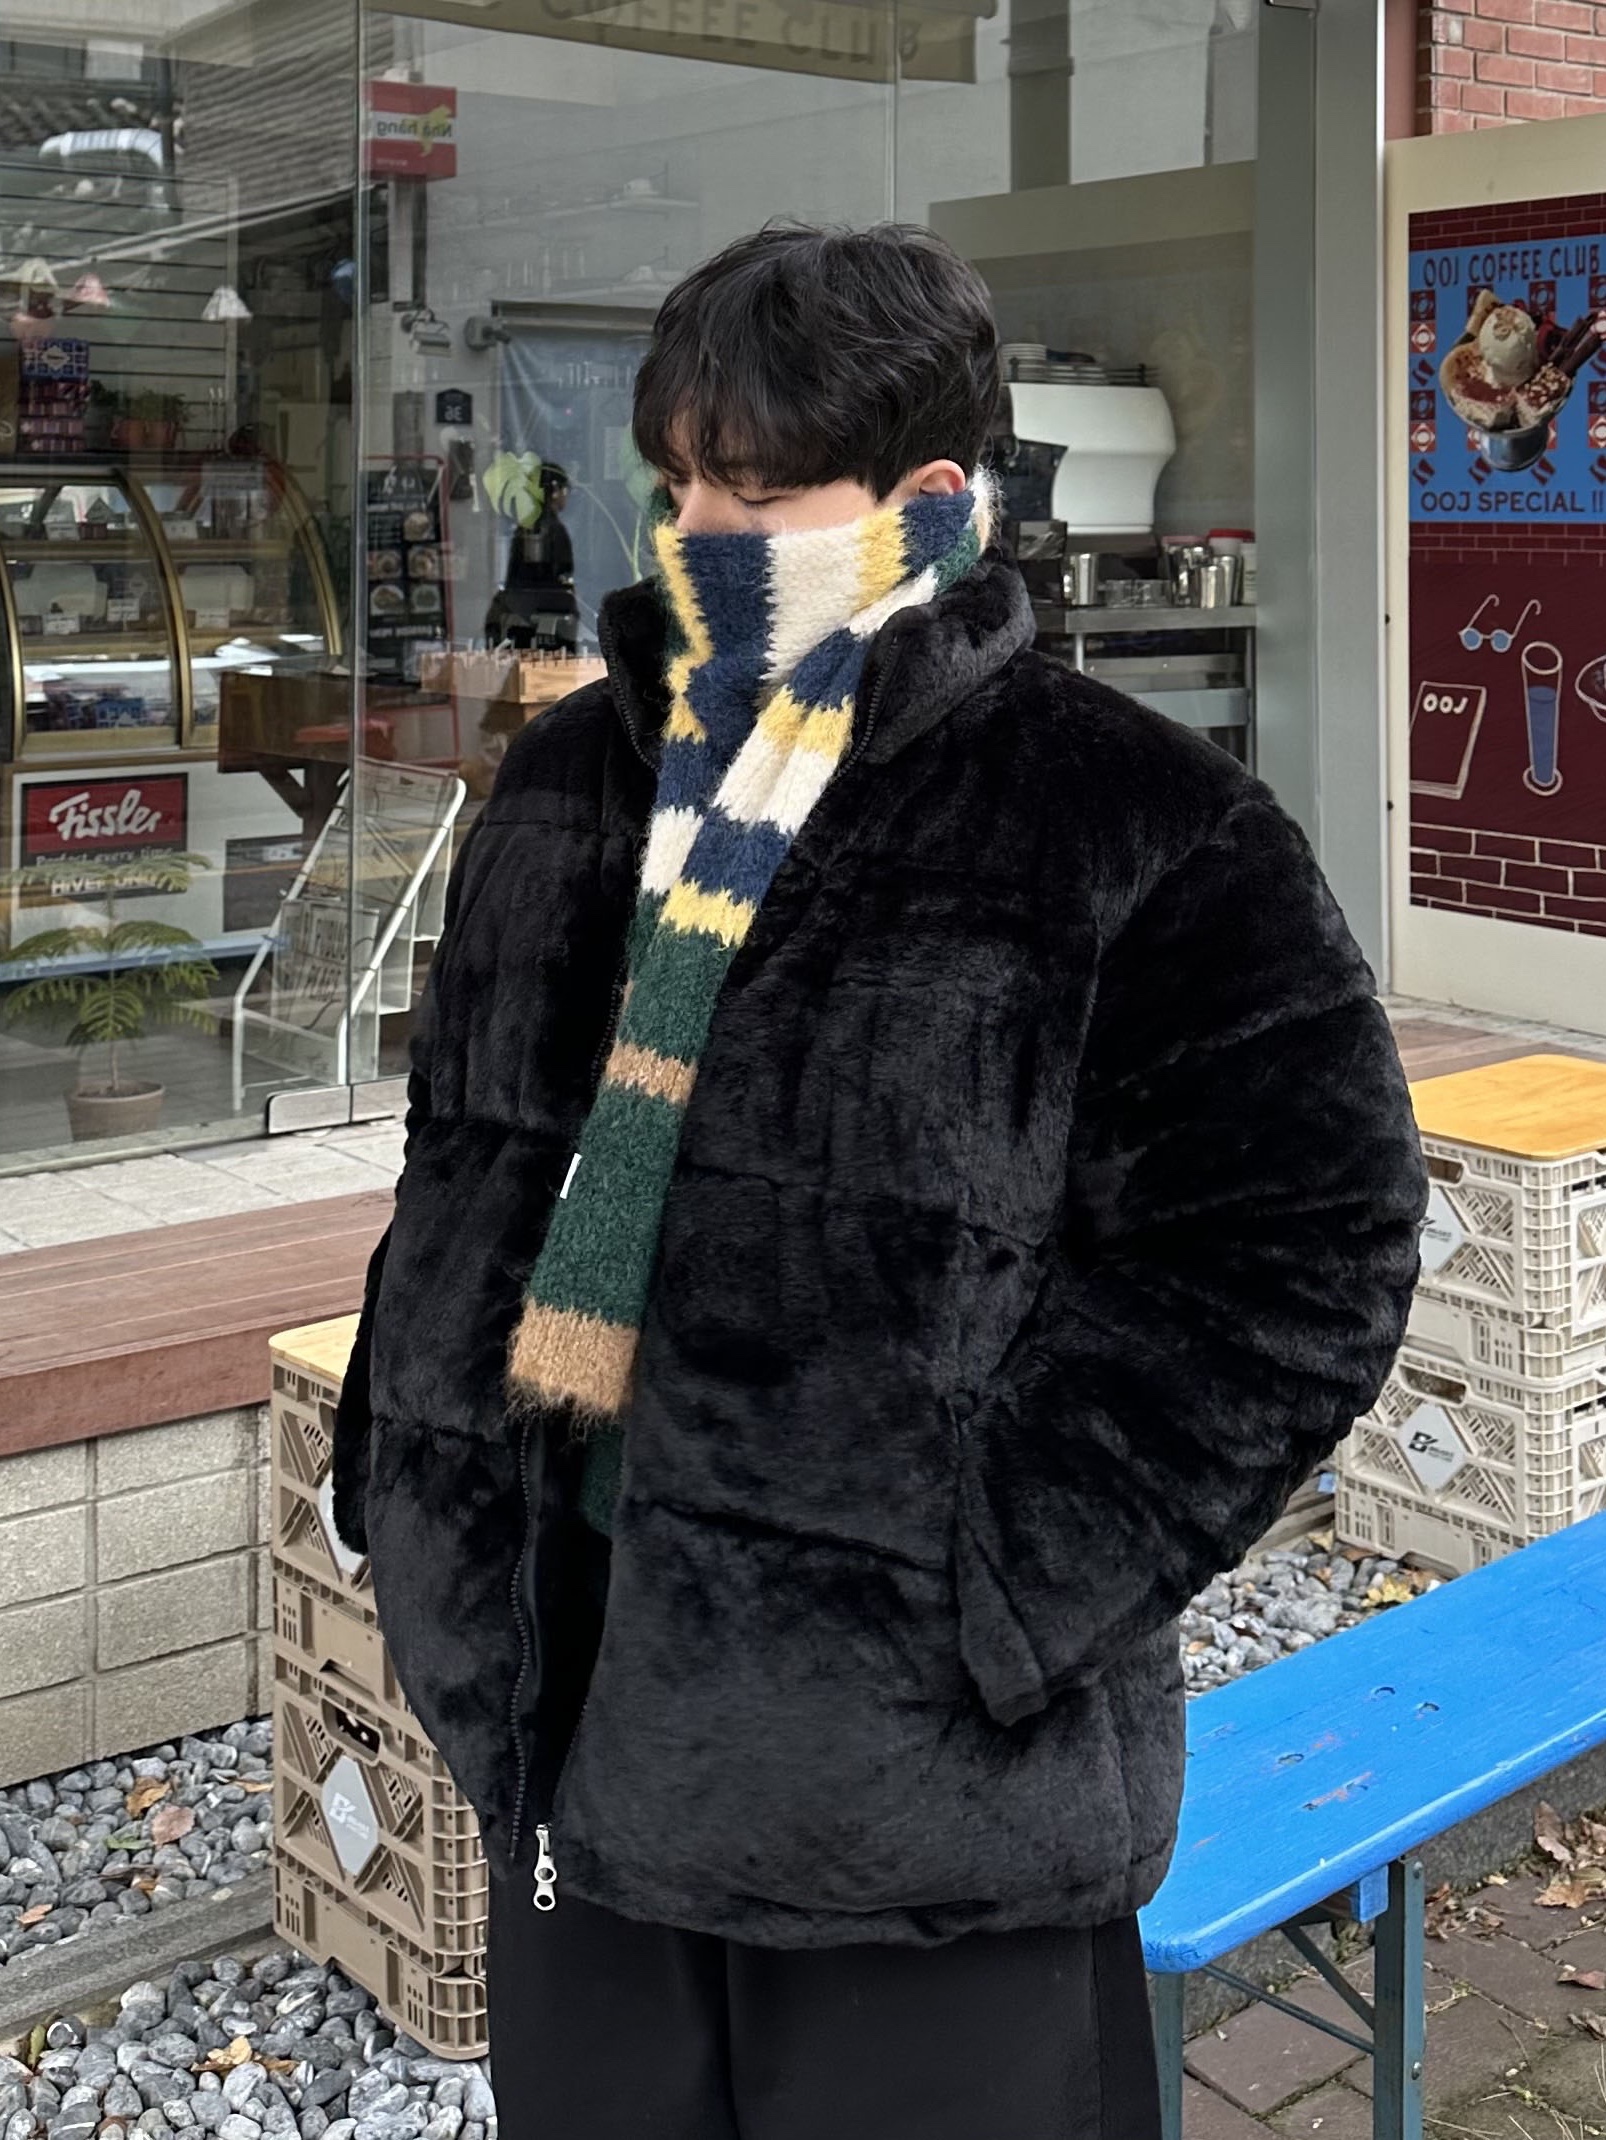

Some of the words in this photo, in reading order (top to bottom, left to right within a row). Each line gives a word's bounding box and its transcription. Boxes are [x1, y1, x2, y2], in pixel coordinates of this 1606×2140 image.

[1423, 256, 1459, 287] OOJ
[1468, 250, 1542, 283] COFFEE
[1550, 244, 1599, 277] CLUB
[1421, 491, 1471, 512] OOJ
[1477, 491, 1585, 512] SPECIAL
[1422, 692, 1468, 714] OOJ
[49, 789, 162, 841] Fissler
